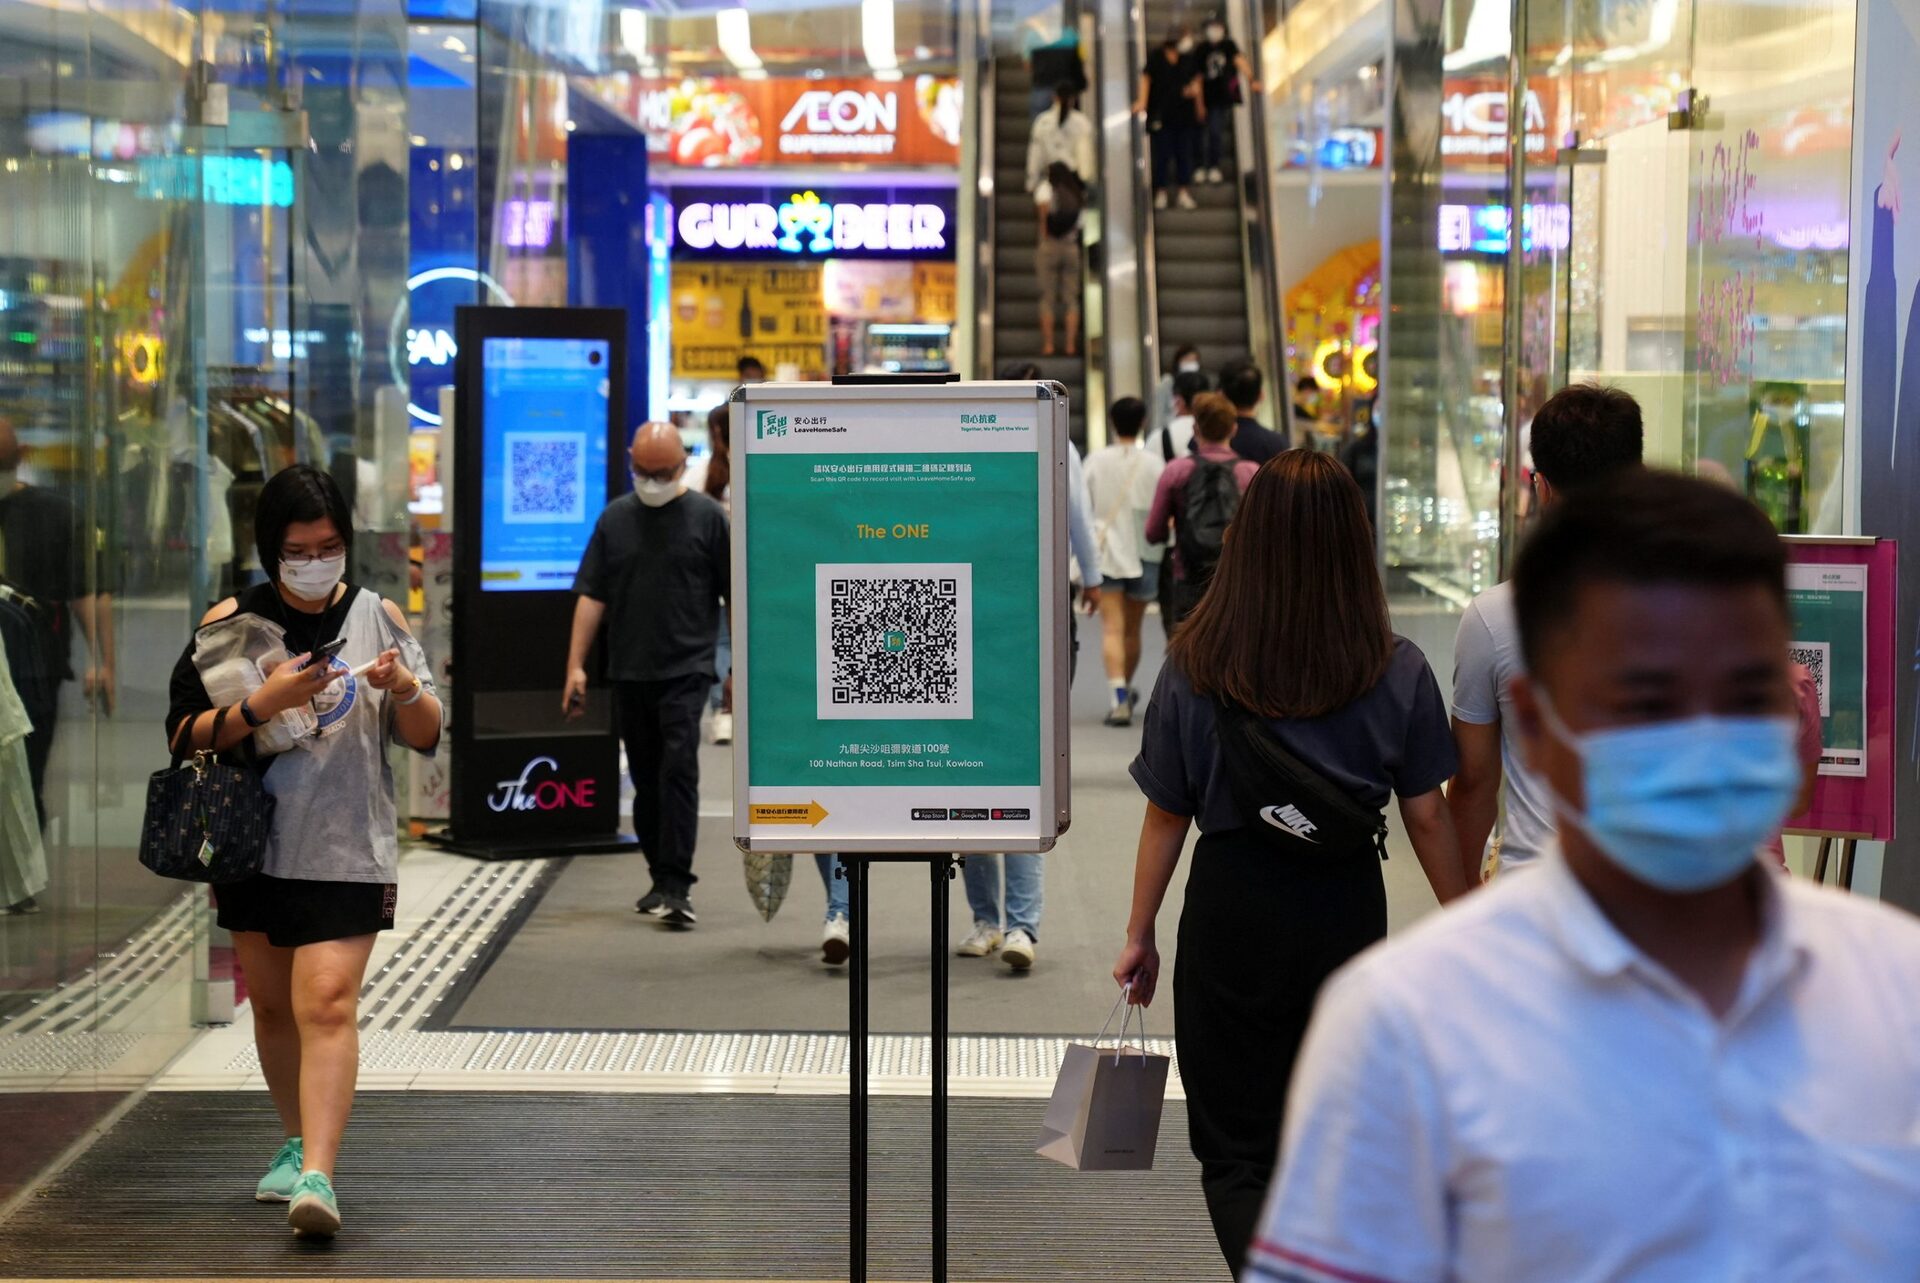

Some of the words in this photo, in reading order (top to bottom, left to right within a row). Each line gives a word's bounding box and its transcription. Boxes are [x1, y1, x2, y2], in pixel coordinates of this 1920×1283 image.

[794, 416, 827, 425] 安心出行
[857, 524, 886, 539] The
[893, 524, 929, 539] ONE
[809, 759, 824, 768] 100
[826, 759, 858, 768] Nathan
[860, 759, 885, 769] Road,
[887, 759, 906, 768] Tsim
[907, 759, 924, 768] Sha
[926, 759, 944, 769] Tsui,
[946, 759, 984, 768] Kowloon
[921, 812, 932, 820] App
[961, 812, 977, 820] Google
[978, 812, 987, 820] Play
[1274, 803, 1318, 834] NIKE
